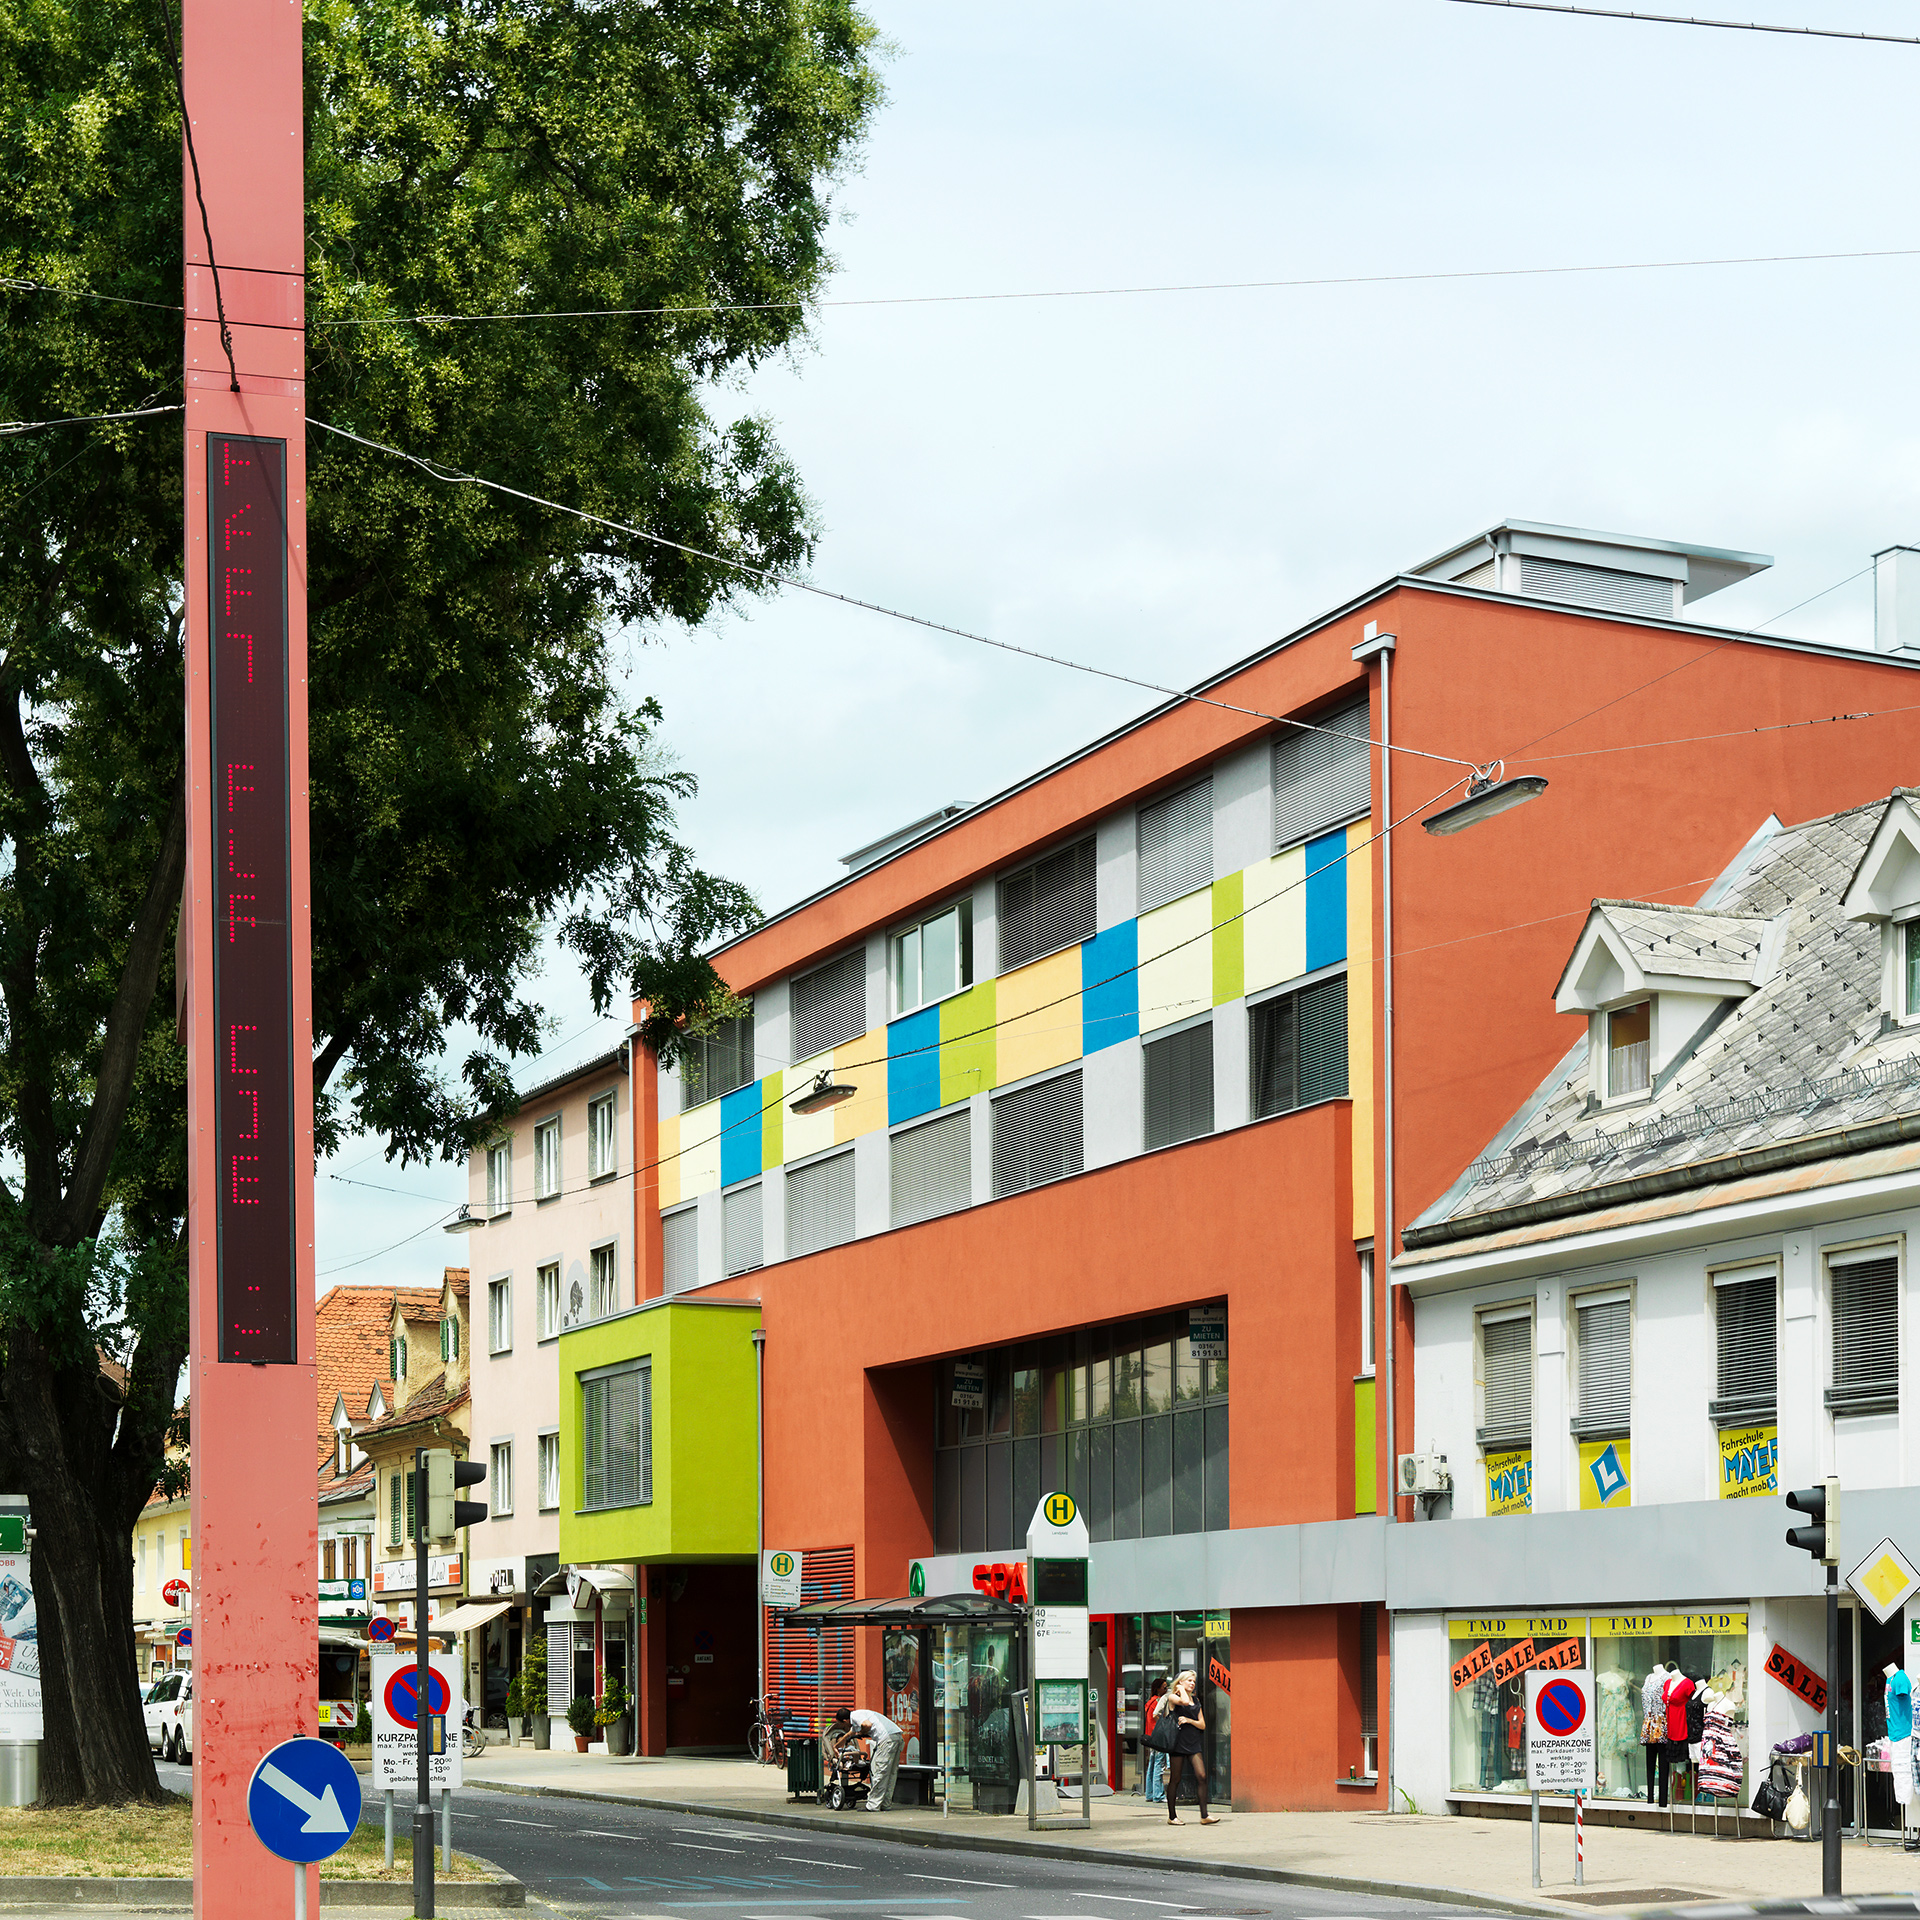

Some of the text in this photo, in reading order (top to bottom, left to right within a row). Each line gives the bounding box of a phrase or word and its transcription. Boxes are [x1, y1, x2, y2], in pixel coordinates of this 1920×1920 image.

[1722, 1430, 1764, 1451] Fahrschule
[1488, 1453, 1522, 1473] Fahrschule
[1727, 1487, 1749, 1499] macht
[1052, 1499, 1068, 1519] H
[1492, 1504, 1509, 1516] macht
[972, 1562, 1028, 1604] SPA
[1035, 1609, 1046, 1617] 40
[1036, 1620, 1046, 1628] 67
[1209, 1621, 1230, 1631] TM
[1467, 1621, 1506, 1632] TMD
[1527, 1619, 1568, 1631] TMD
[1609, 1617, 1653, 1630] TMD
[1684, 1615, 1730, 1628] TMD
[1495, 1645, 1534, 1680] SALE
[1539, 1645, 1579, 1670] SALE
[1453, 1649, 1492, 1687] SALE
[1768, 1653, 1827, 1708] SALE
[377, 1734, 458, 1742] KURZPANE
[1531, 1740, 1592, 1748] KURZPARKZONE
